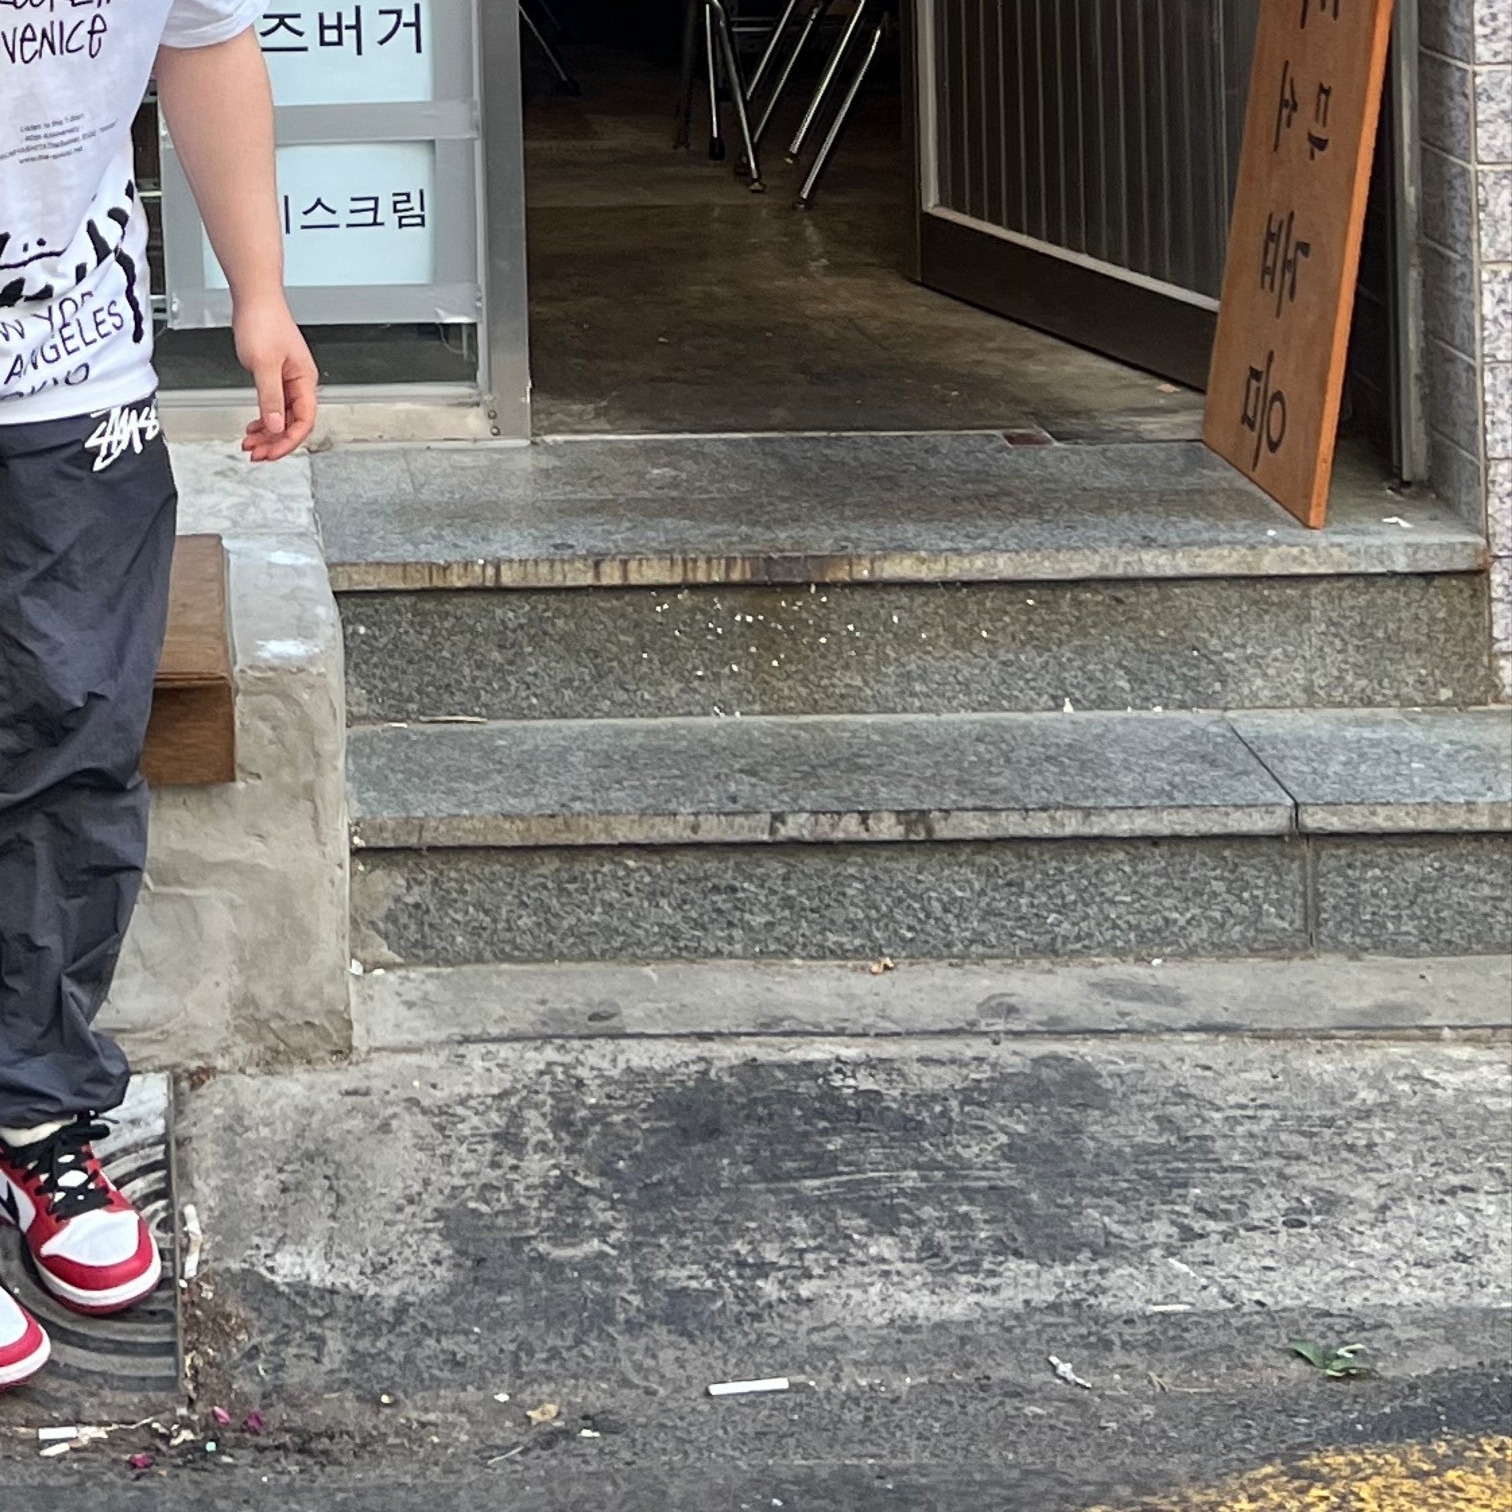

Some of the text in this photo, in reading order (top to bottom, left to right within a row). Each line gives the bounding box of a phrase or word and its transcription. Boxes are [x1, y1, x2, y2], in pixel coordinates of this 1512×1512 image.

[258, 2, 424, 56] 즈버거
[284, 189, 428, 234] 스크림
[3, 299, 125, 385] ANGELES
